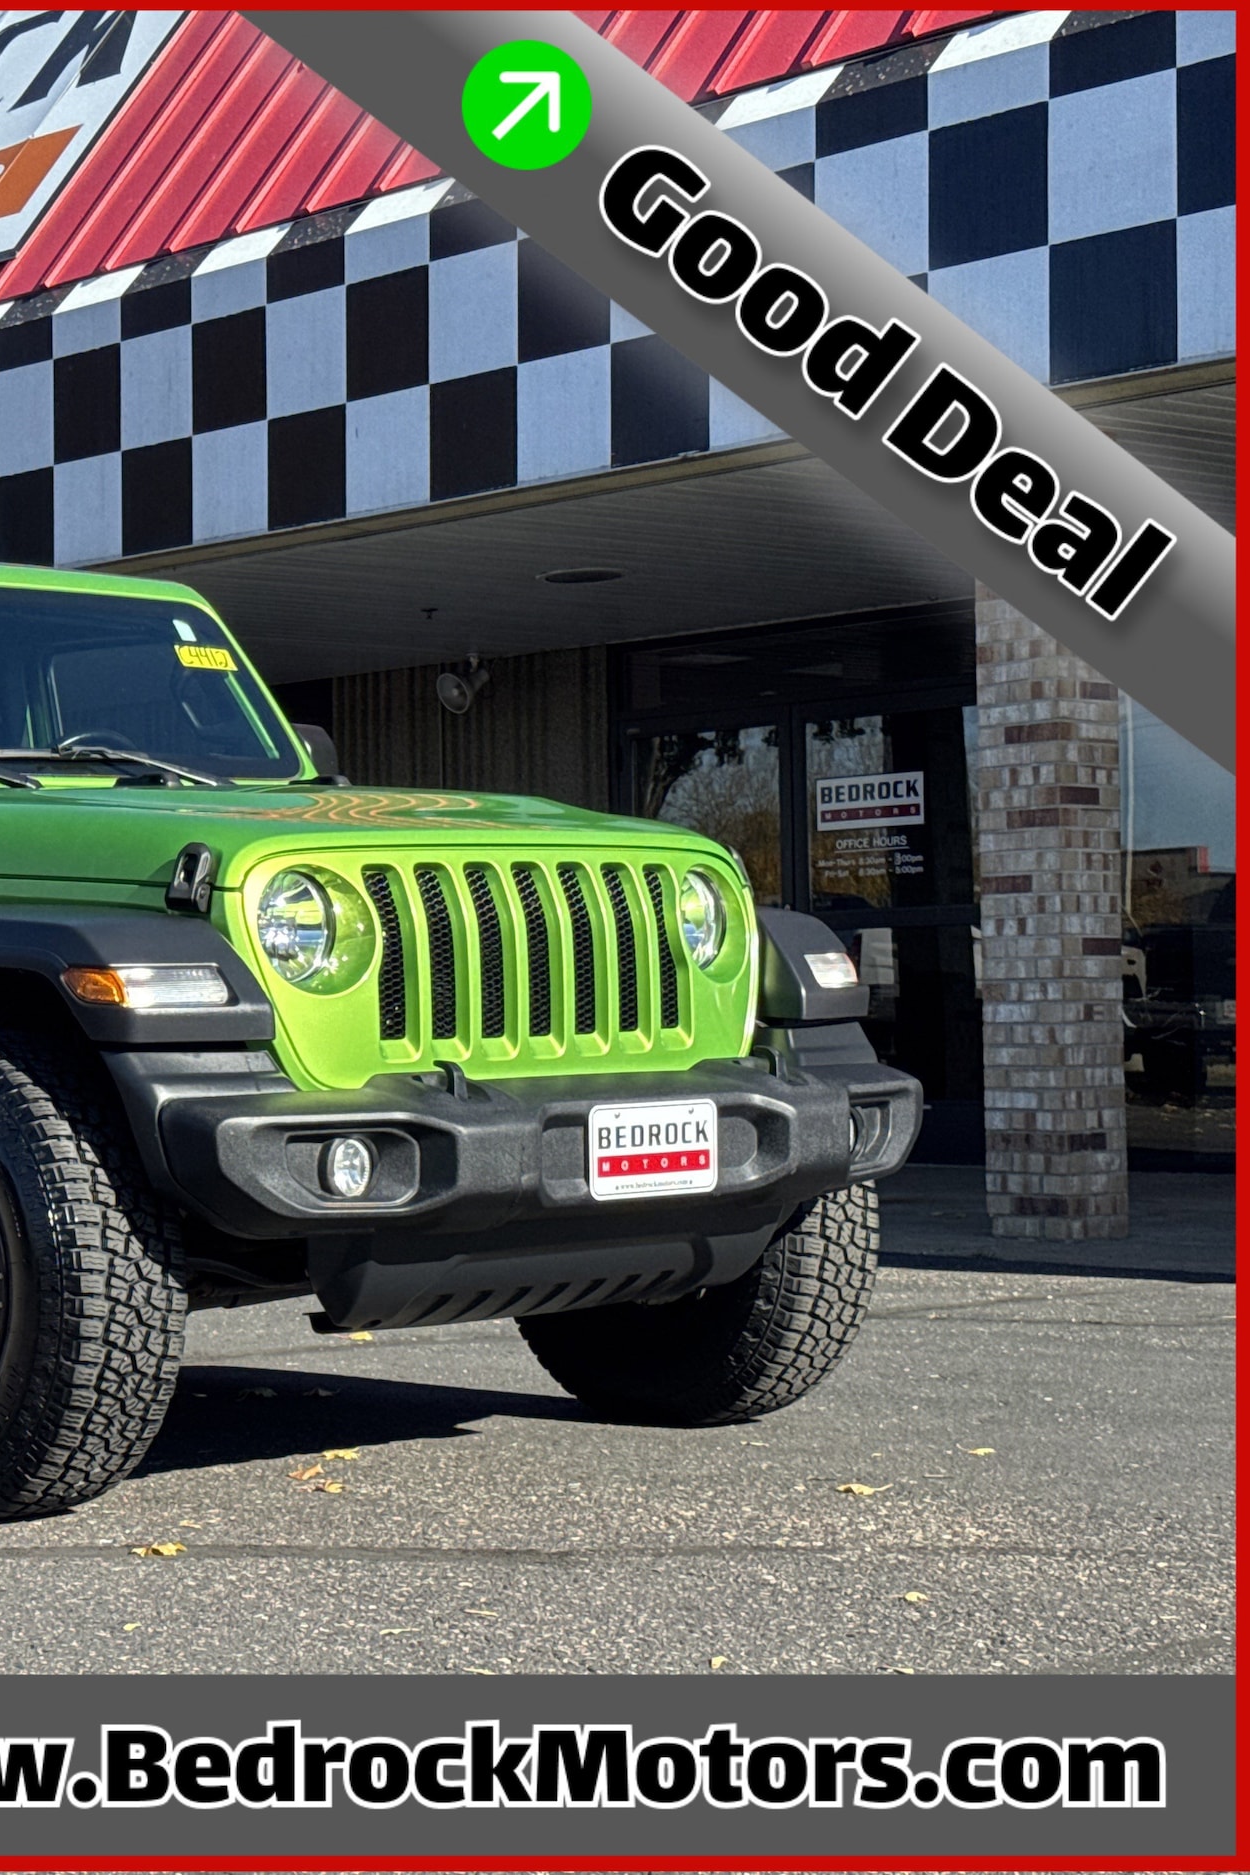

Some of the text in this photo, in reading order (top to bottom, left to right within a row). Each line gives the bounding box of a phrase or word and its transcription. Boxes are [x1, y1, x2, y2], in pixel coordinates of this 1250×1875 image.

[820, 779, 920, 804] BEDROCK
[824, 806, 917, 819] MOTORS
[835, 835, 908, 850] OFFICE HOURS
[597, 1120, 709, 1150] BEDROCK
[601, 1154, 706, 1173] MOTORS
